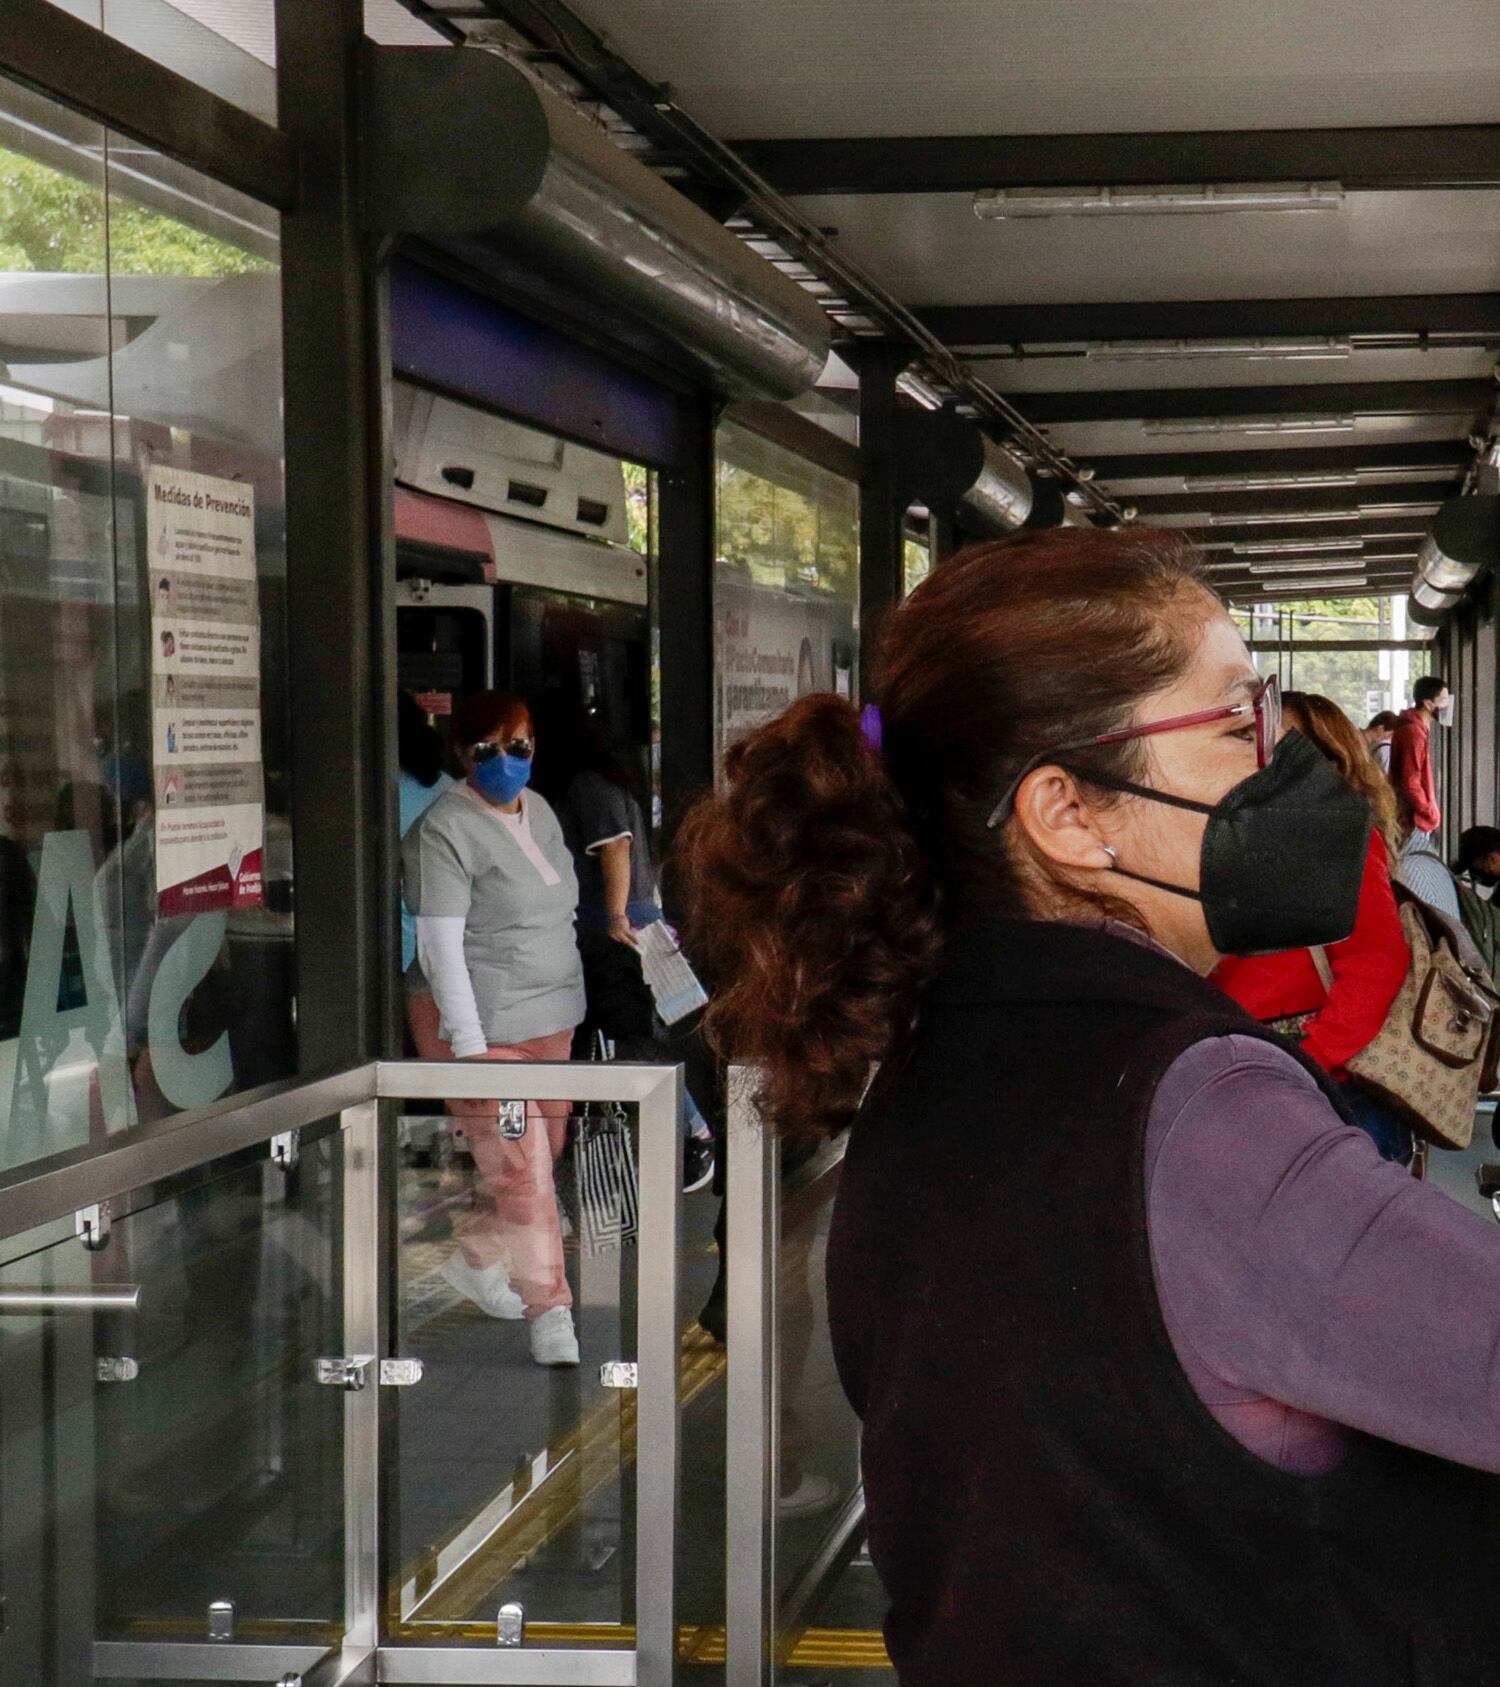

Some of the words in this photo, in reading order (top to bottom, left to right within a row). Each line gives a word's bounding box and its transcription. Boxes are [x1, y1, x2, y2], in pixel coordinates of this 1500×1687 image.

[154, 484, 191, 507] Medidas
[193, 491, 204, 509] de
[205, 494, 251, 518] Prevención
